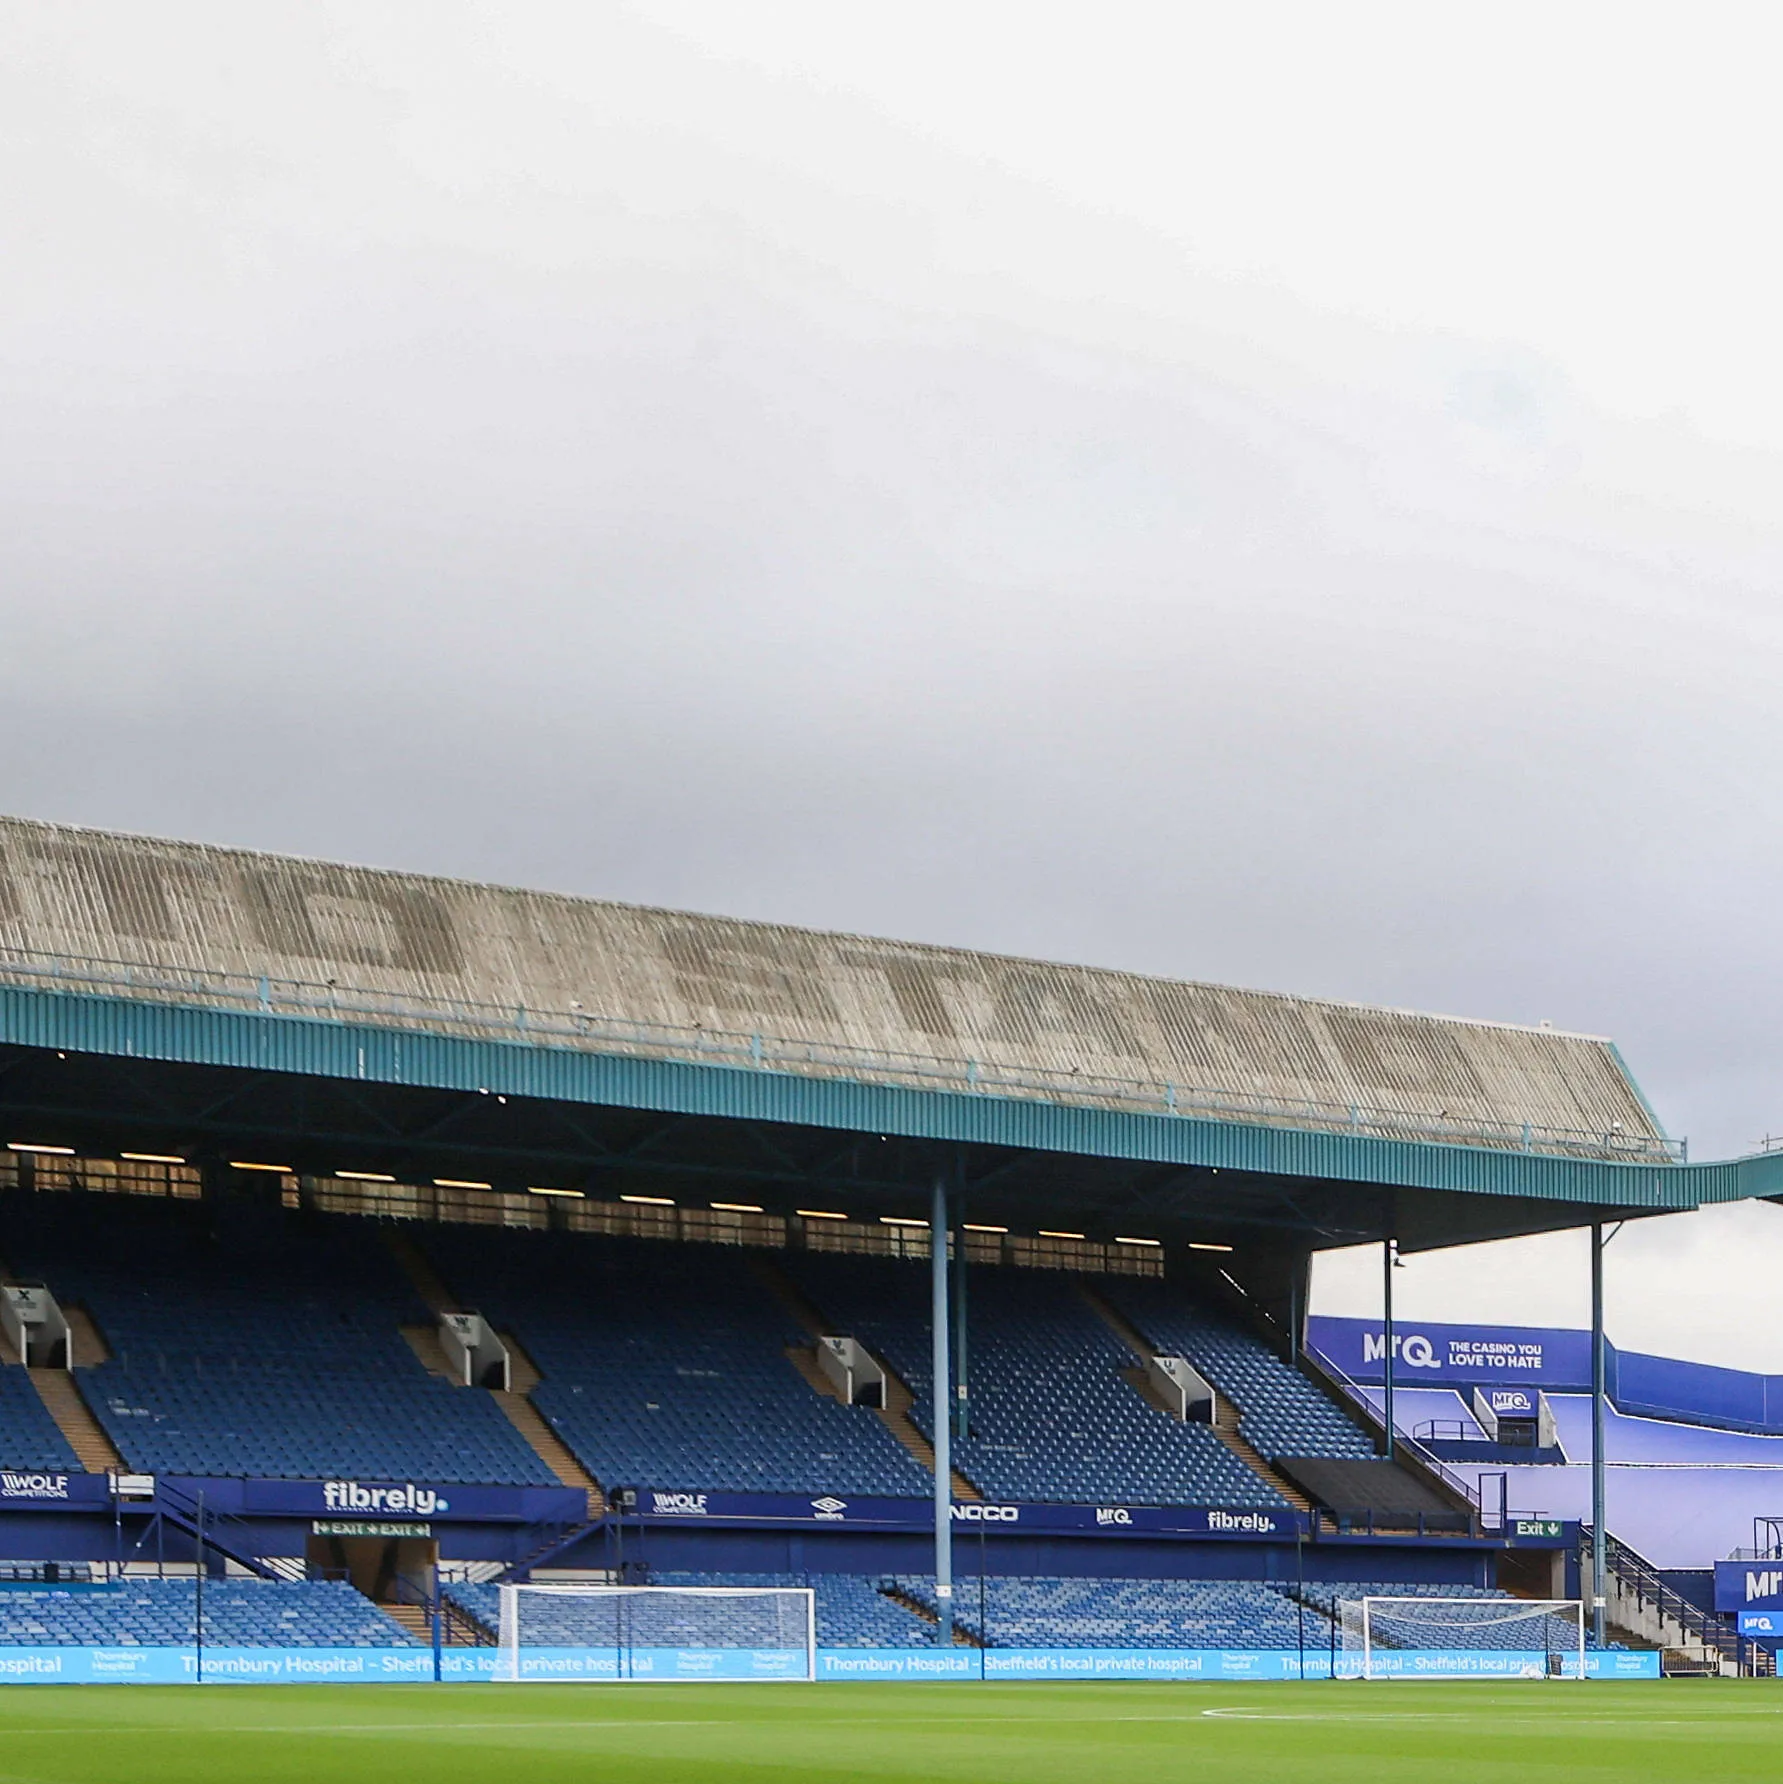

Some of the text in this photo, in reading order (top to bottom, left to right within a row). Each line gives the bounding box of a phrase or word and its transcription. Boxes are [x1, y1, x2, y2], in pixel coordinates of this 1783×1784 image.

[1364, 1333, 1441, 1368] MrQ
[1449, 1341, 1542, 1355] THE CASINO YOU
[1449, 1354, 1542, 1368] LOVE TO HATE
[1492, 1392, 1530, 1411] MrQ
[16, 1475, 68, 1490] WOLF
[1096, 1508, 1132, 1525] MrQ
[331, 1522, 412, 1535] EXIT EXIT
[1517, 1521, 1544, 1535] Exit
[1745, 1617, 1773, 1630] MrQ
[286, 1656, 363, 1674] Hospital
[522, 1656, 582, 1674] private
[823, 1656, 902, 1674] Thornbury
[906, 1656, 969, 1673] Hospital
[983, 1656, 1058, 1671] Sheffield's
[1060, 1656, 1093, 1671] local
[1095, 1656, 1144, 1673] private
[1147, 1656, 1202, 1673] hospital
[1415, 1656, 1478, 1671] Sheffield's
[1480, 1656, 1507, 1671] local
